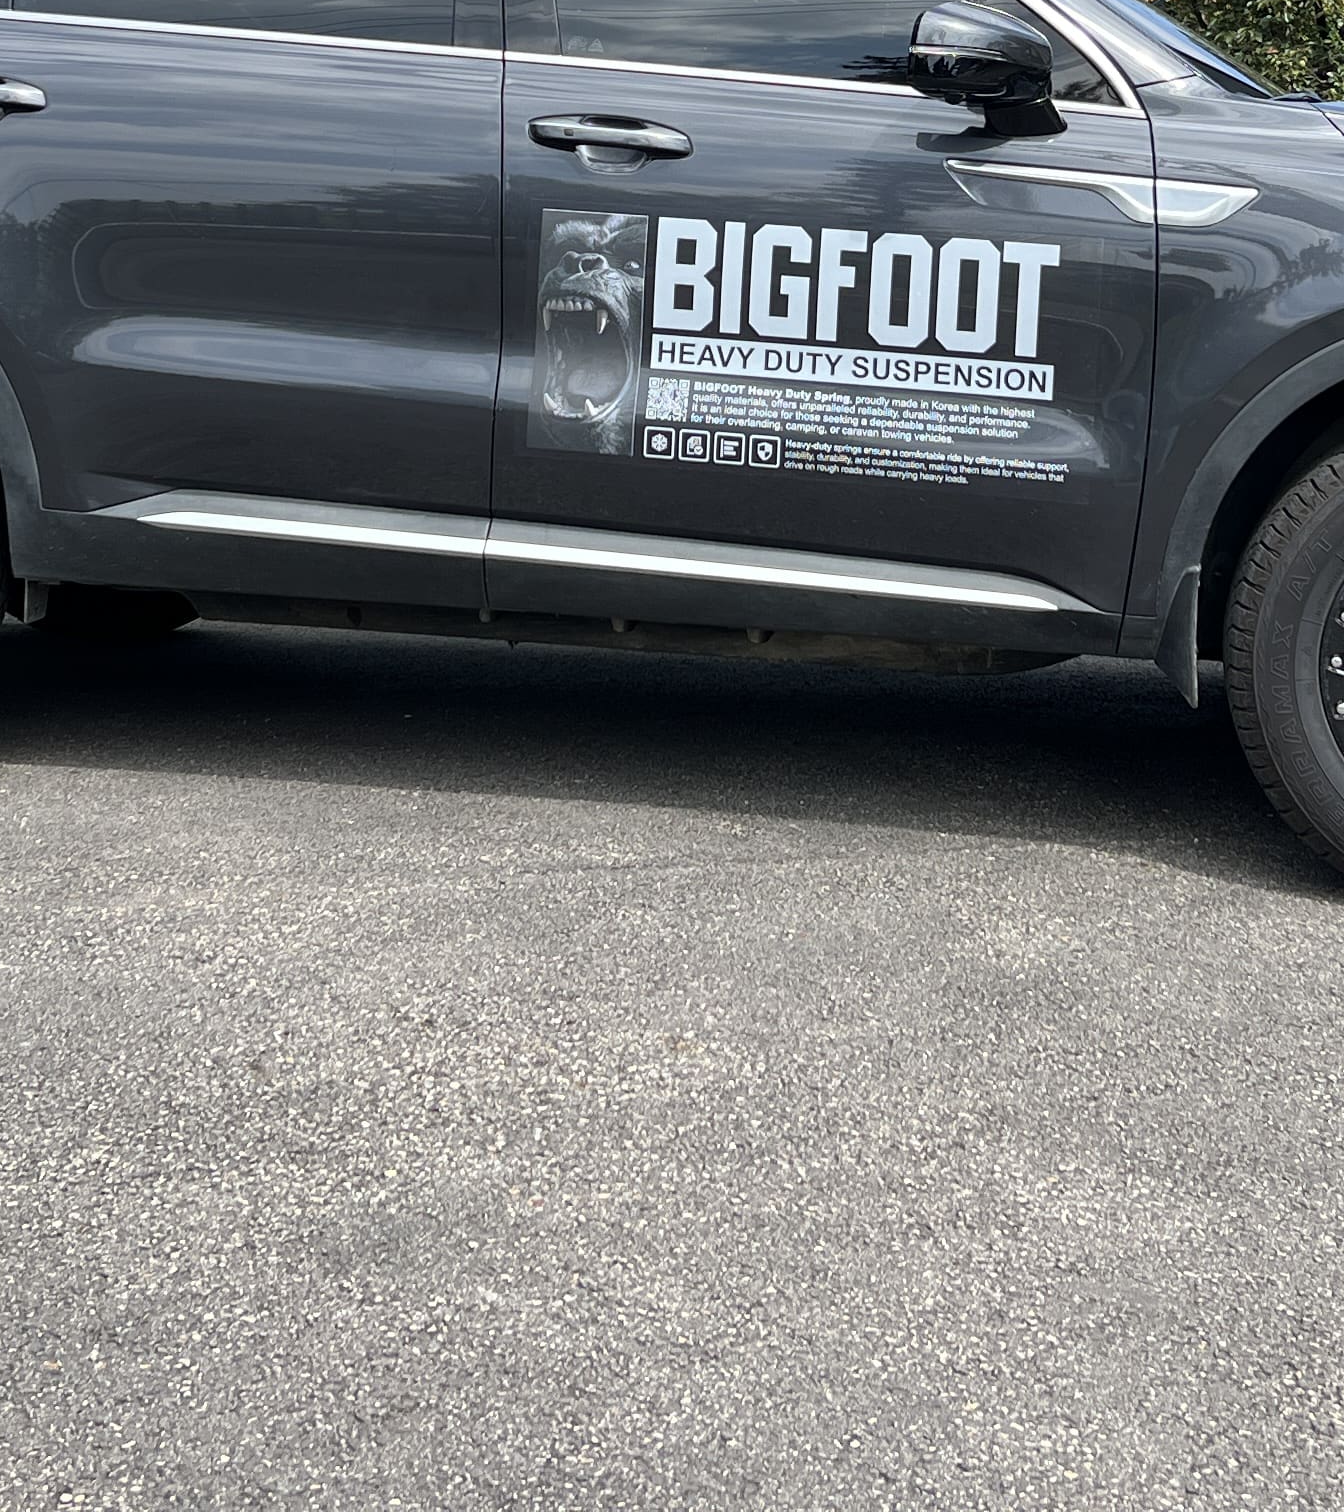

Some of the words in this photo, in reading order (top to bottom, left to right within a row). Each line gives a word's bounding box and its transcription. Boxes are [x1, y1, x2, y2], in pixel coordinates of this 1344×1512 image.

[652, 215, 1062, 359] BIGFOOT
[657, 340, 755, 369] HEAVY
[763, 348, 844, 377] DUTY
[852, 356, 1048, 394] SUSPENSION
[692, 393, 722, 405] quality
[724, 395, 768, 408] materials,
[771, 399, 797, 410] offers
[799, 401, 855, 415] unparalleled
[858, 405, 900, 419] reliability,
[902, 408, 946, 423] durability,
[949, 413, 967, 424] and
[969, 414, 1031, 429] performance.
[694, 381, 745, 395] BIGFOOT
[748, 385, 783, 399] Heavy
[786, 388, 812, 402] Duty
[856, 395, 890, 409] proudly
[892, 398, 918, 409] made
[921, 399, 929, 410] in
[931, 400, 959, 412] Korea
[961, 402, 981, 413] with
[983, 404, 998, 415] the
[1000, 406, 1035, 419] highest
[690, 413, 704, 423] for
[705, 414, 726, 426] their
[727, 417, 784, 431] overlanding,
[785, 421, 827, 435] camping,
[829, 425, 840, 435] or
[842, 426, 879, 438] caravan
[881, 429, 912, 442] towing
[700, 403, 708, 413] is
[710, 405, 722, 414] an
[724, 405, 746, 416] ideal
[748, 407, 779, 419] choice
[781, 409, 794, 420] for
[795, 411, 821, 422] those
[822, 413, 859, 427] seeking
[861, 417, 867, 426] a
[869, 417, 924, 432] dependable
[926, 422, 980, 436] suspension
[982, 427, 1019, 439] solution
[785, 438, 832, 453] Heavy-duty
[833, 443, 862, 456] springs
[863, 447, 890, 457] ensure
[899, 449, 946, 461] comfortable
[946, 453, 962, 463] ride
[963, 454, 974, 465] by
[975, 456, 1005, 468] offering
[1006, 458, 1035, 469] reliable
[854, 456, 870, 465] and
[928, 462, 957, 474] making
[959, 464, 980, 475] them
[981, 467, 1001, 477] ideal
[1002, 469, 1013, 478] for
[1014, 470, 1047, 481] vehicles
[1048, 473, 1065, 483] that
[784, 460, 803, 470] drive
[804, 461, 815, 470] on
[817, 462, 839, 474] rough
[840, 465, 863, 475] roads
[864, 467, 885, 477] while
[886, 469, 918, 481] carrying
[920, 471, 944, 484] heavy
